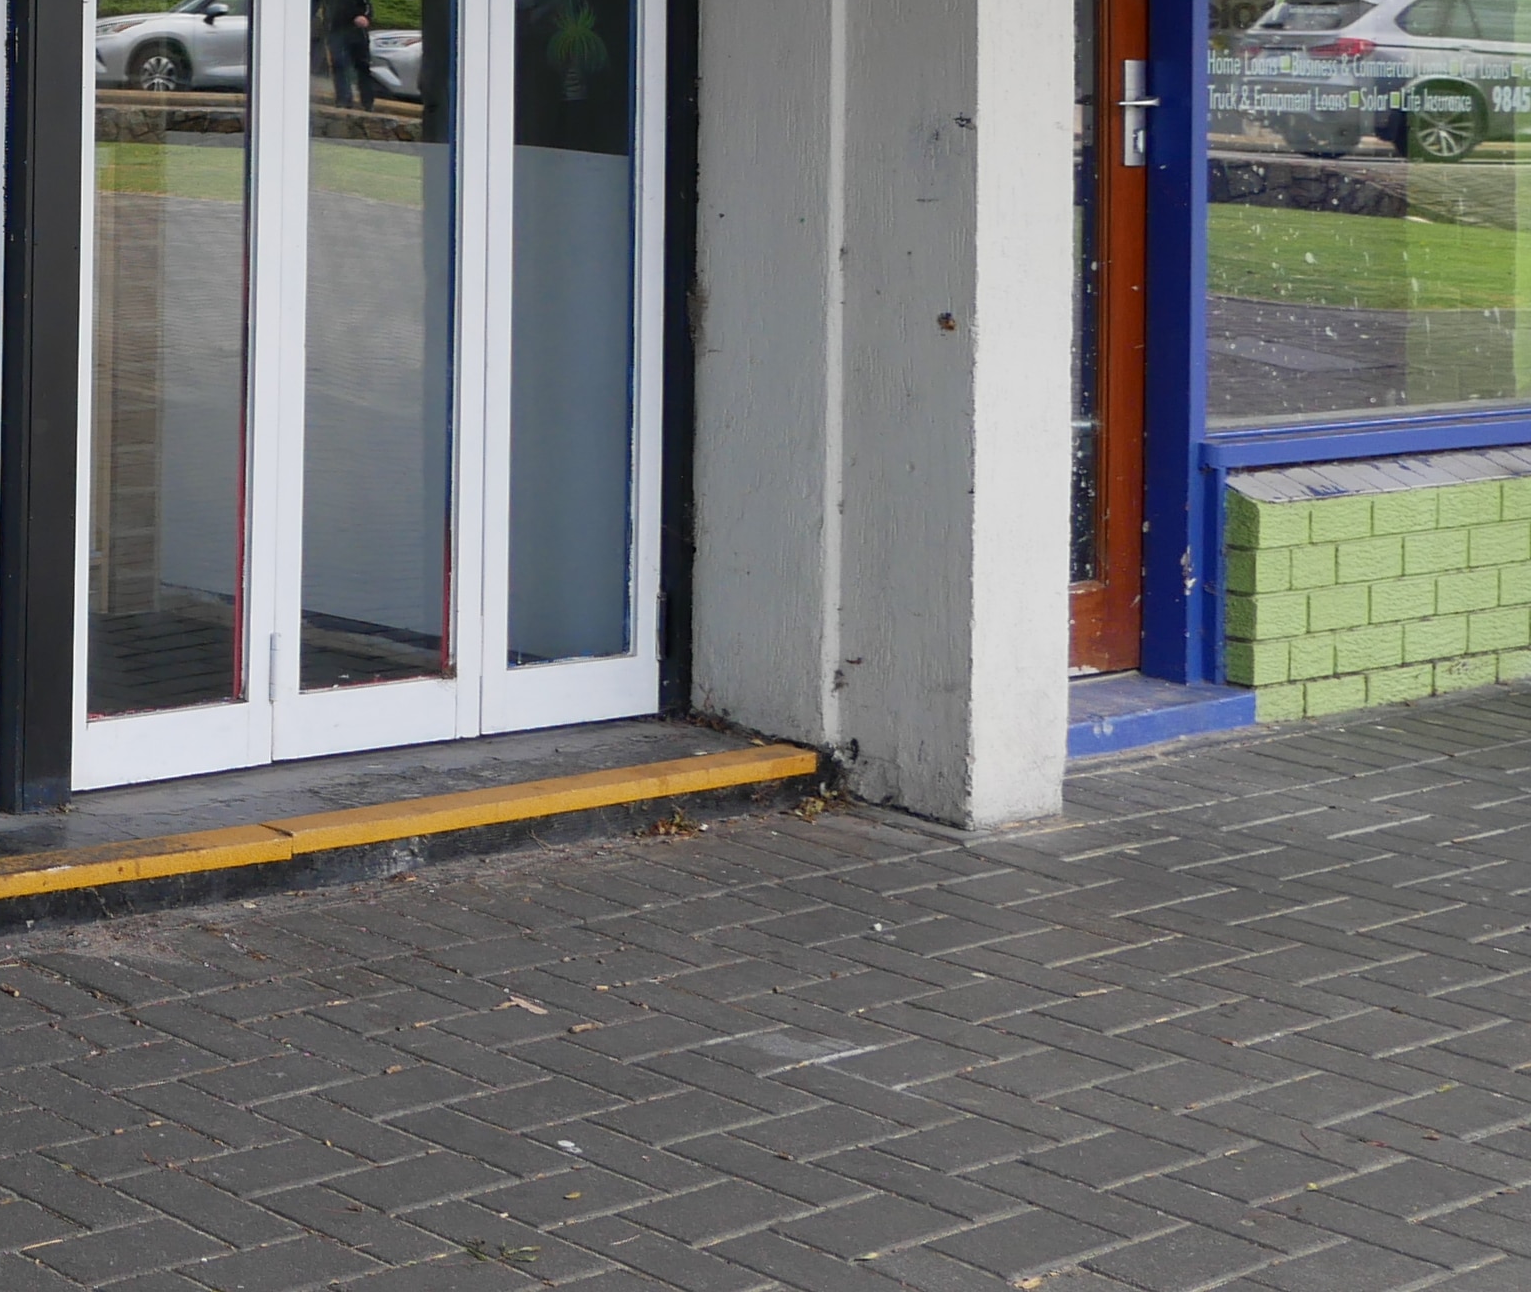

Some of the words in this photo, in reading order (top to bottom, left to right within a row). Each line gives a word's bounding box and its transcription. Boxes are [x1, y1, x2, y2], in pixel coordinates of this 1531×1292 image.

[1207, 50, 1241, 75] Home
[1245, 51, 1278, 76] Loans
[1291, 53, 1338, 76] Business
[1341, 54, 1349, 76] &
[1353, 54, 1414, 78] Commercial
[1207, 85, 1237, 110] Truck
[1255, 84, 1312, 115] Equipment
[1315, 87, 1348, 111] Loans
[1360, 86, 1389, 112] Solar
[1401, 88, 1421, 112] Life
[1424, 88, 1472, 112] Insurance
